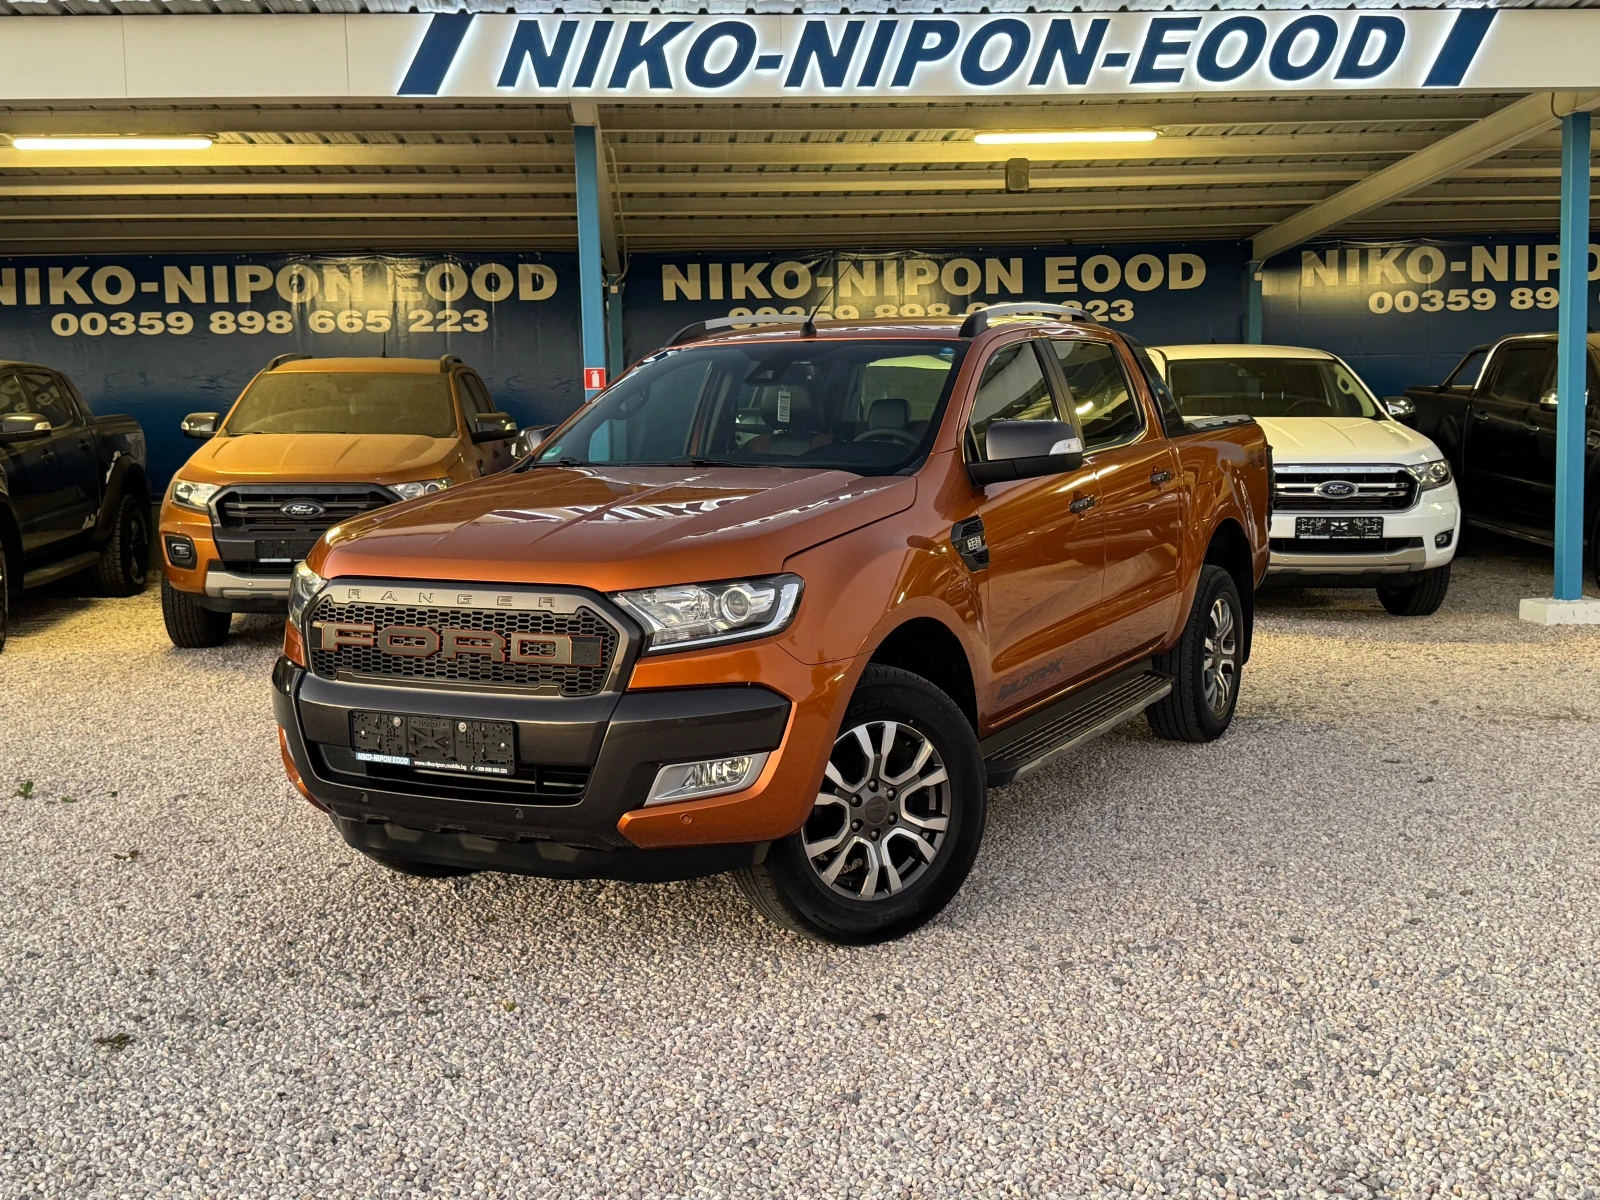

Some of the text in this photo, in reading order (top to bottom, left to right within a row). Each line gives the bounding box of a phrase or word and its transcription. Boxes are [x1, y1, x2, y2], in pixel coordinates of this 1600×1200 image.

[496, 15, 1406, 88] NIKO-NIPON-EOOD
[386, 263, 558, 301] EOOD
[661, 253, 1207, 301] NIKO-NIPON EOOD
[1301, 244, 1600, 287] NIKO-NIP
[1368, 286, 1560, 314] 00359 89
[51, 309, 489, 337] 00359 898 665 223
[1327, 484, 1350, 495] Ford
[290, 504, 314, 515] Ford
[347, 588, 556, 608] RANGER
[318, 621, 577, 666] FORD
